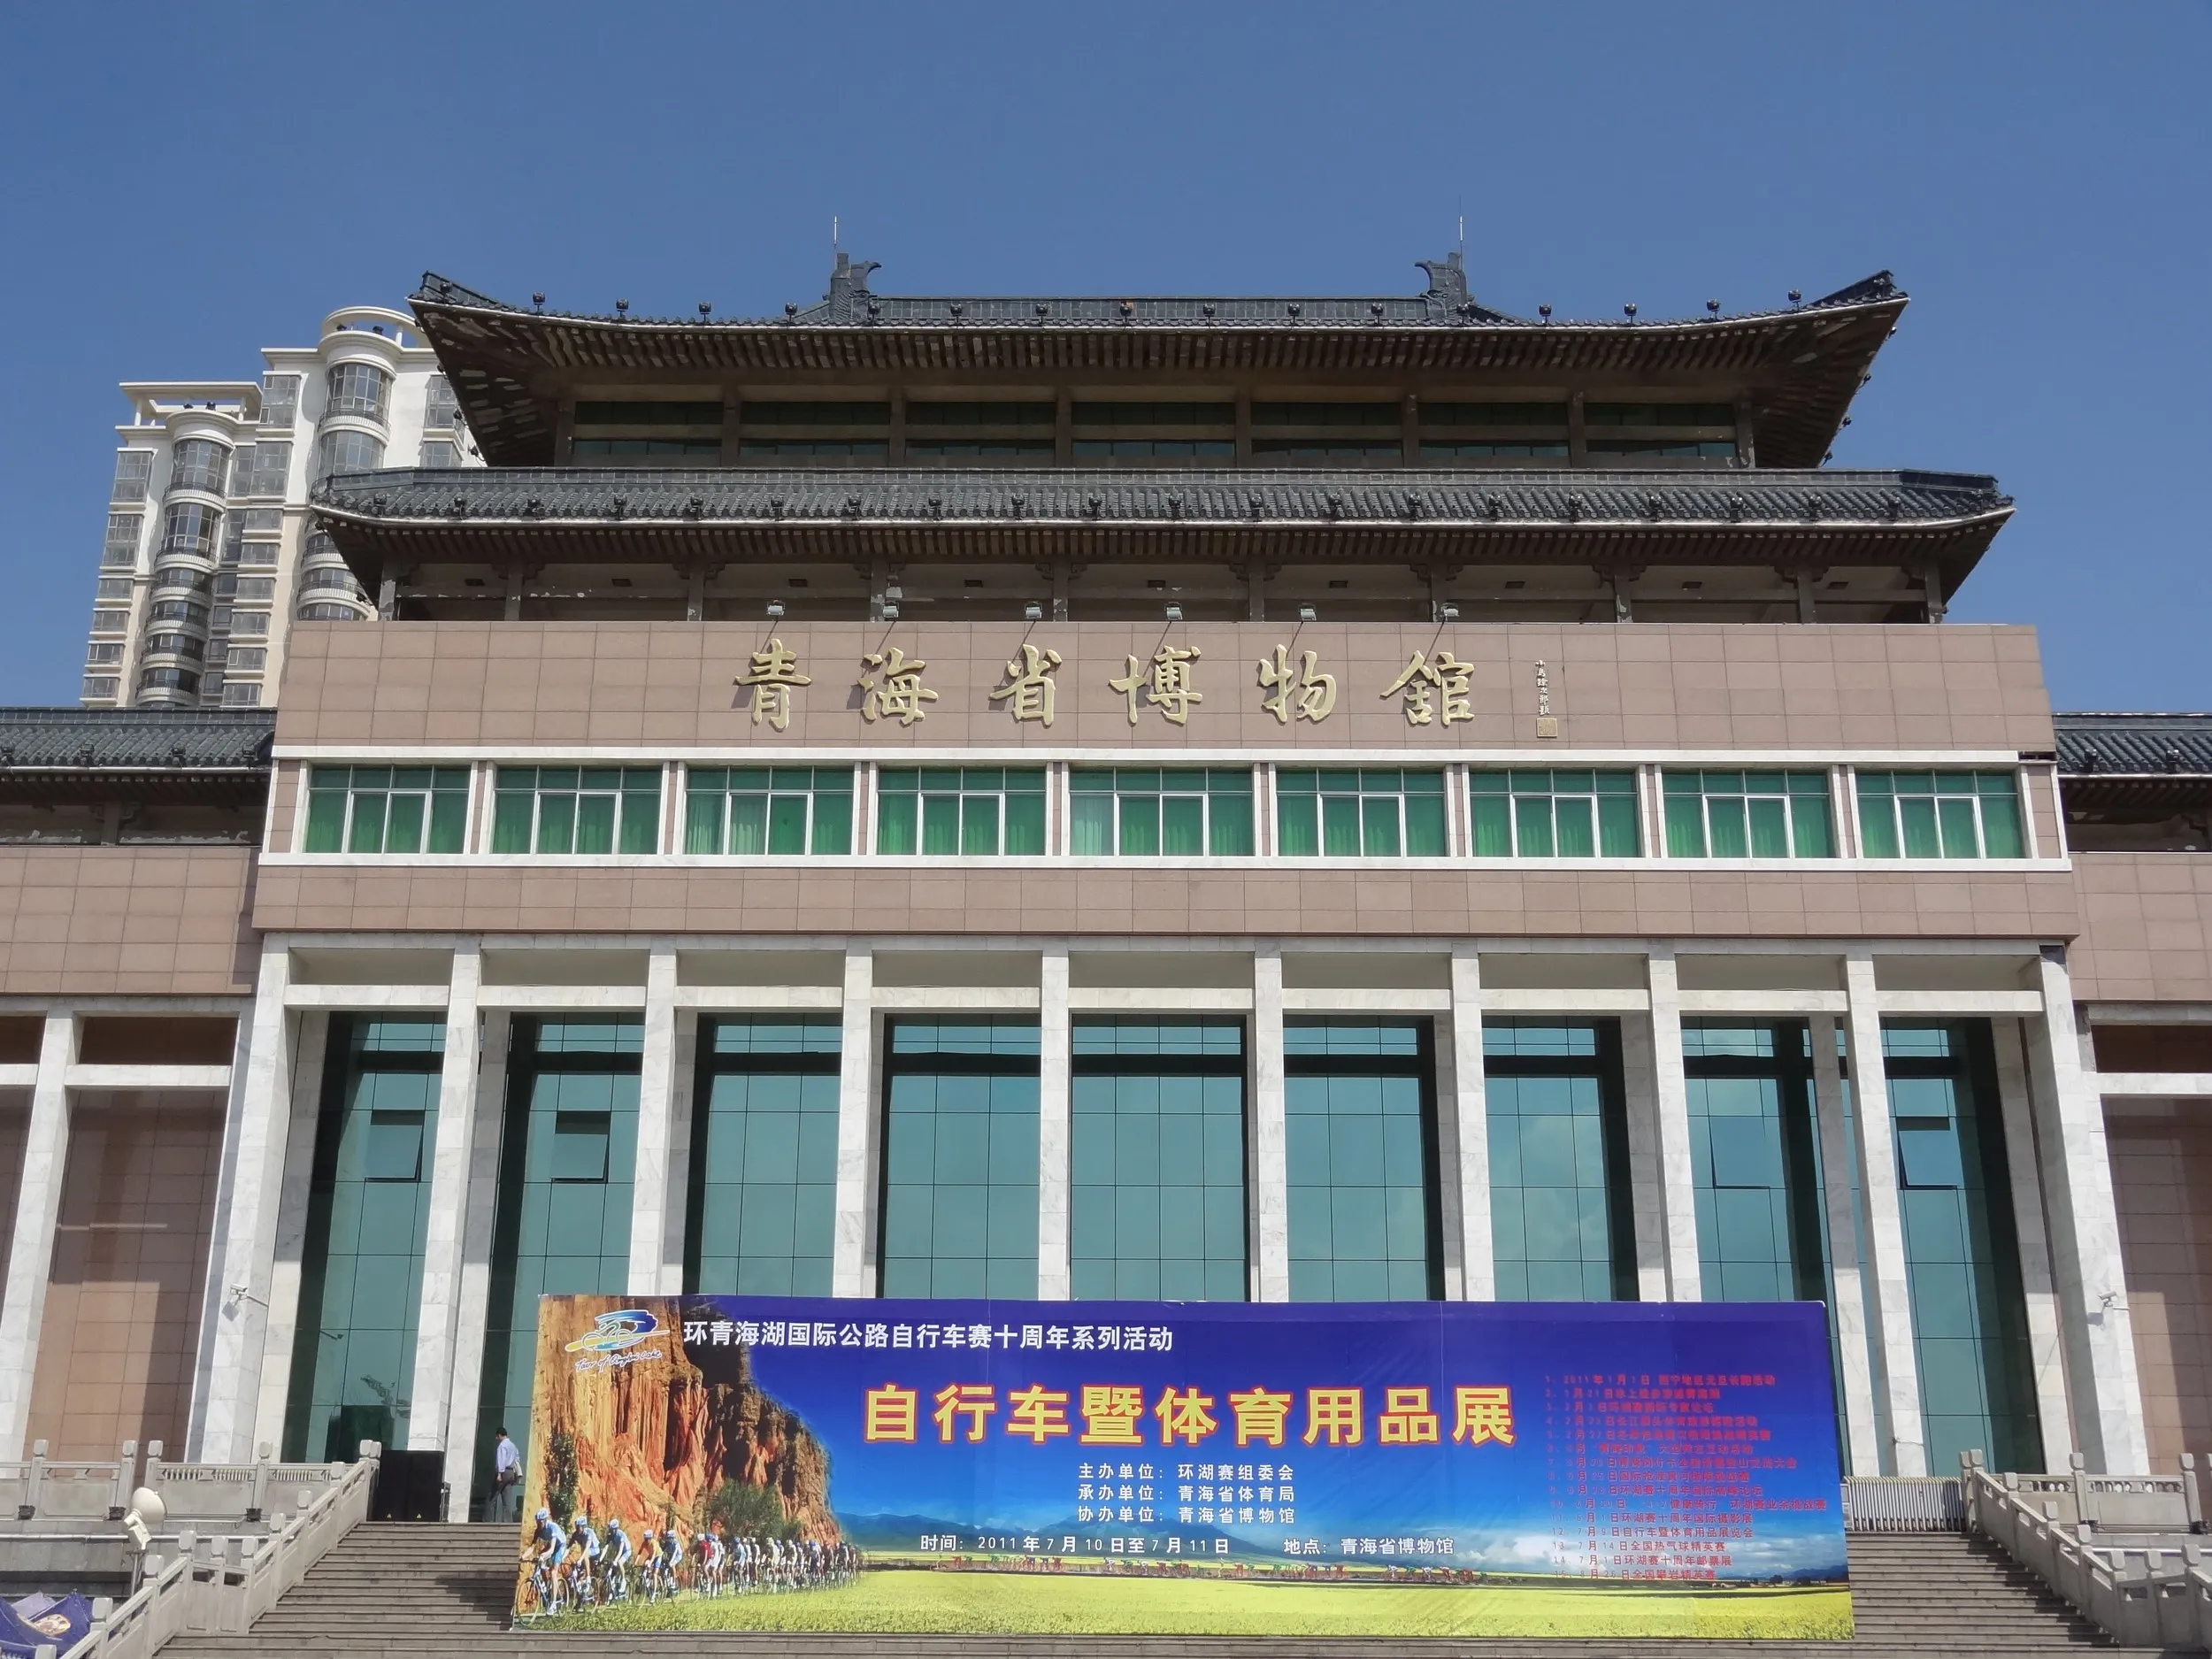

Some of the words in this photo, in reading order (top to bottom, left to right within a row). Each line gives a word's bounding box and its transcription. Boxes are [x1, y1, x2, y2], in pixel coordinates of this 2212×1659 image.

[735, 636, 1475, 730] 青海省博物館
[684, 1320, 1172, 1351] 环青海湖国际公路自行车赛十周年系列活动
[575, 1358, 597, 1371] Tour
[598, 1354, 610, 1372] of
[864, 1383, 1516, 1446] 自行车暨体育用品展
